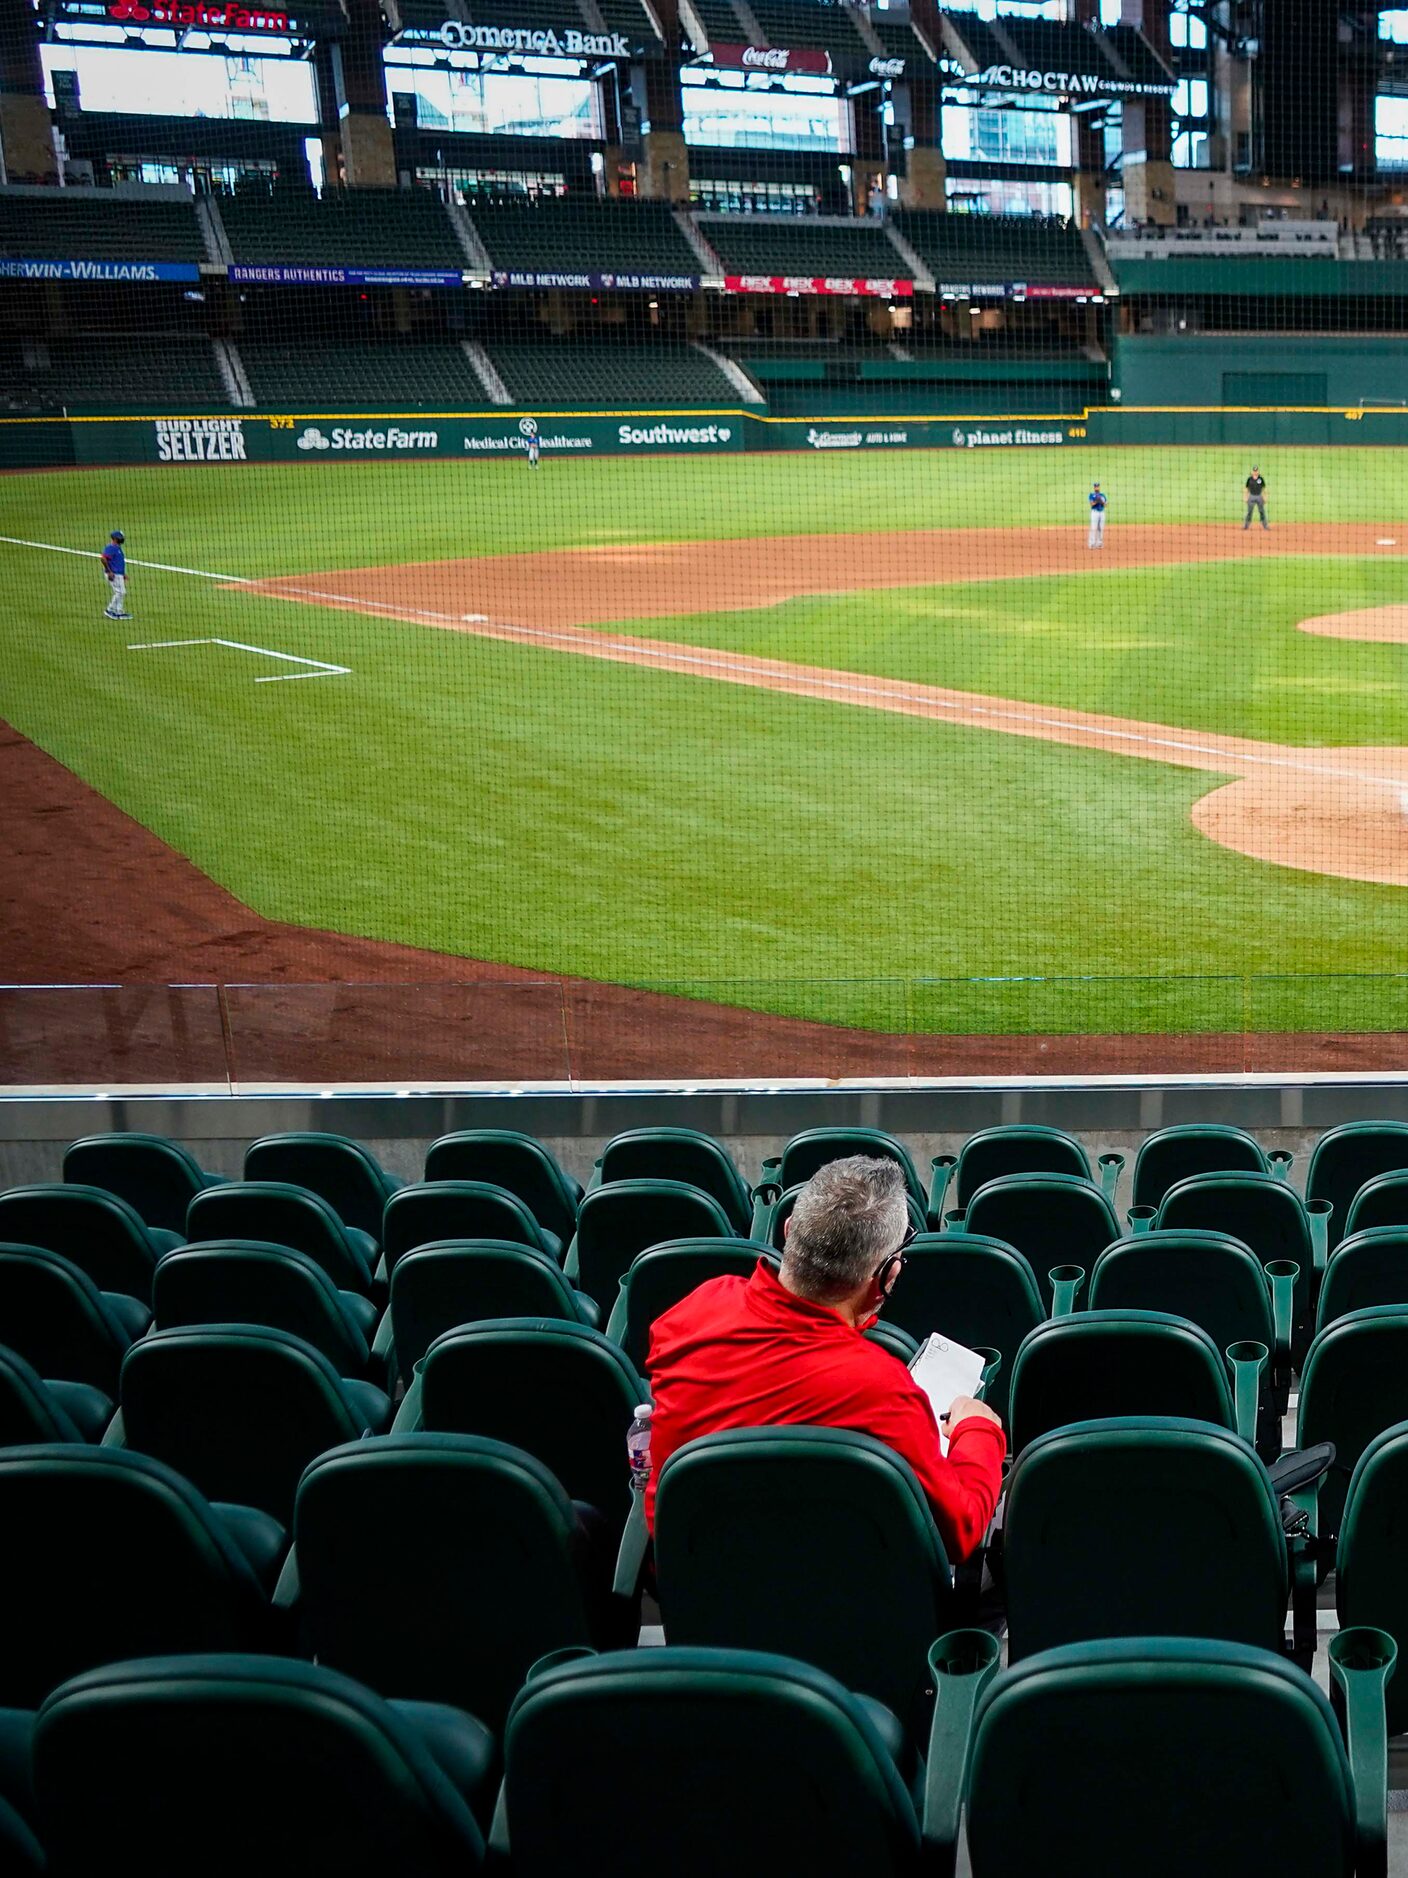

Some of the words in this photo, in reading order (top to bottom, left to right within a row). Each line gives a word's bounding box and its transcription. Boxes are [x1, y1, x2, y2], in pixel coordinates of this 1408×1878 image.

[565, 29, 631, 57] Bank
[999, 65, 1099, 93] CHOCTAW
[234, 267, 281, 280] RANGERS
[283, 268, 345, 282] AUTHENTICS
[510, 273, 535, 286] MLB
[536, 274, 590, 287] NETWORK
[616, 275, 639, 287] MLB
[641, 275, 693, 289] NETWORK
[155, 419, 192, 432] BUD
[193, 419, 242, 432] LIGHT
[618, 424, 717, 444] Southwest
[967, 430, 1013, 447] planet
[1014, 429, 1063, 444] fitness
[157, 432, 247, 461] SELTZER
[464, 436, 508, 450] Medical
